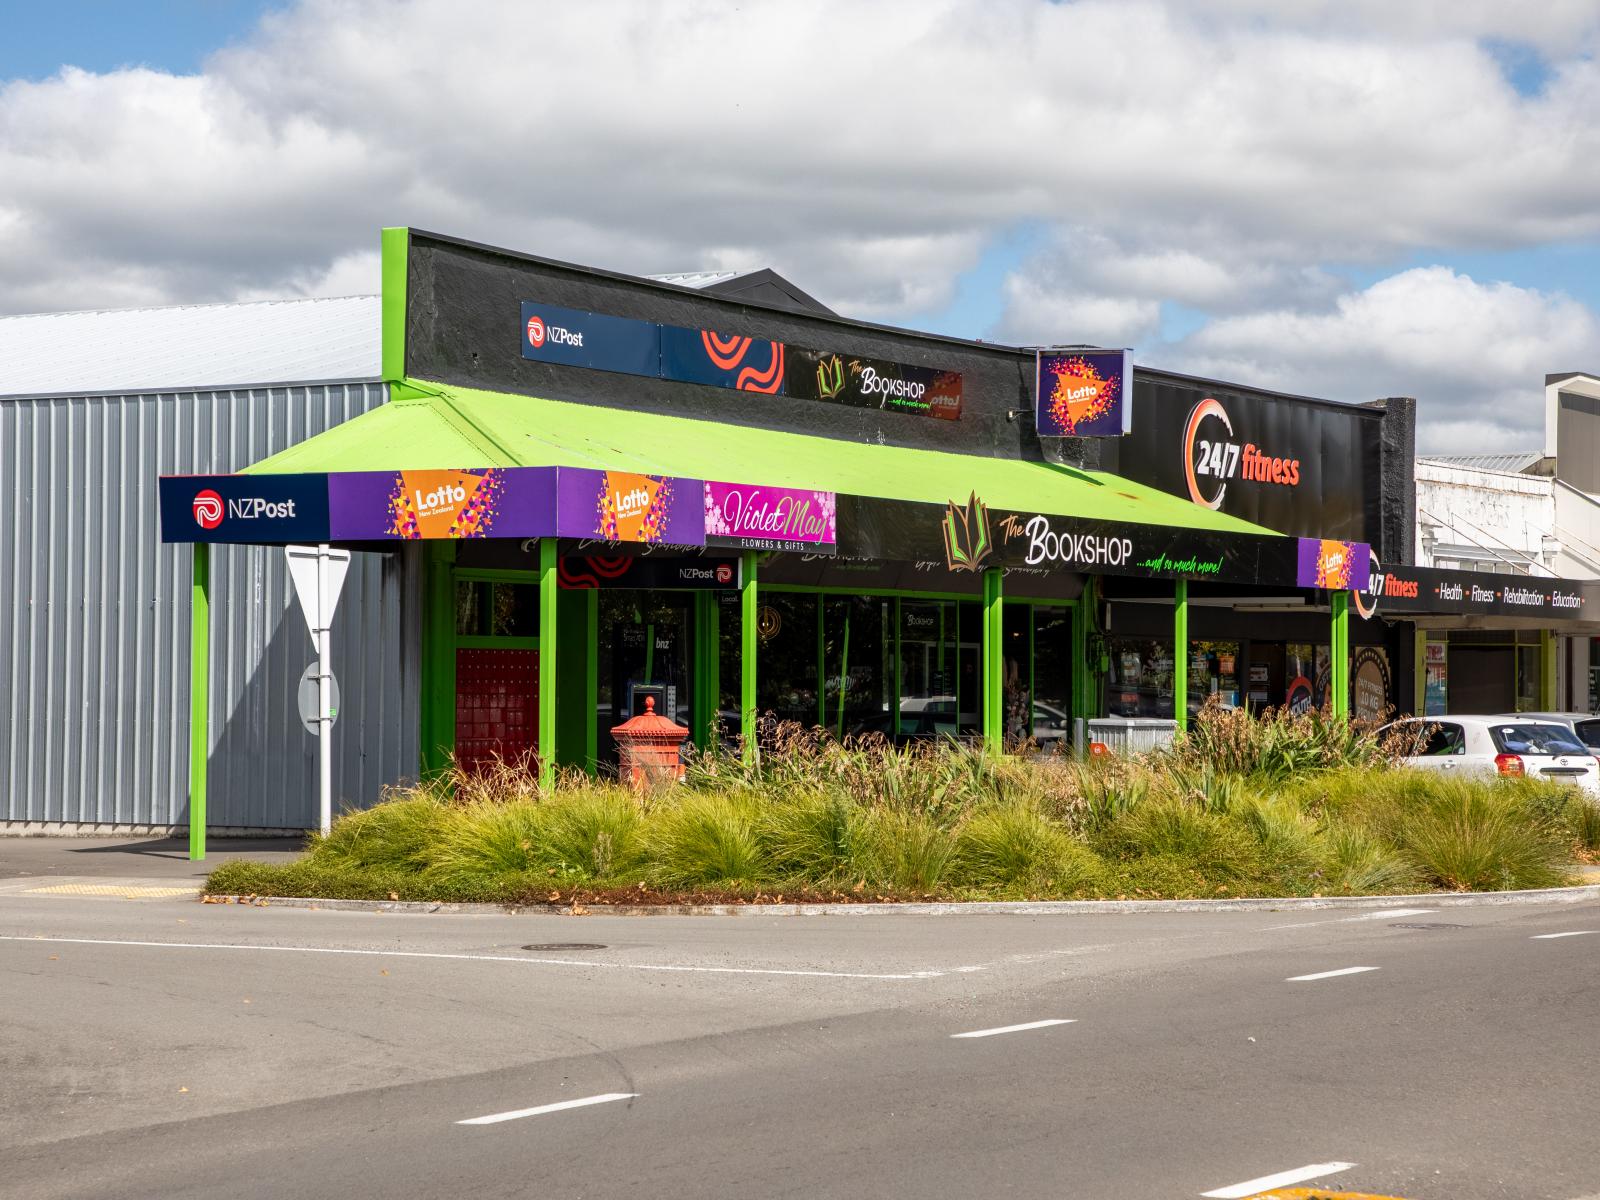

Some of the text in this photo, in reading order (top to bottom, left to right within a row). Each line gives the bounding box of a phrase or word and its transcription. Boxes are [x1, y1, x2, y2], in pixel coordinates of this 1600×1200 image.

[547, 325, 583, 346] NZPost
[848, 360, 925, 399] The BOOKSHOP
[1067, 386, 1097, 400] Lotto
[1197, 440, 1299, 485] 24/7 fitness
[228, 498, 296, 518] NZPost
[415, 485, 466, 511] Lotto
[616, 489, 649, 512] Lotto
[418, 505, 455, 518] New Zealand
[723, 490, 828, 545] Violet May
[741, 539, 804, 551] FLOWERS & GIFTS
[1000, 514, 1132, 566] The BOOKSHOP
[1164, 558, 1172, 569] so
[1173, 556, 1197, 572] much
[1198, 556, 1224, 574] more!
[1326, 551, 1342, 570] Lotto
[680, 568, 714, 579] NZPost
[1385, 573, 1418, 598] fitness
[1440, 583, 1463, 600] Health
[1471, 585, 1494, 602] Fitness
[1552, 590, 1581, 608] Education
[655, 637, 670, 649] bnz
